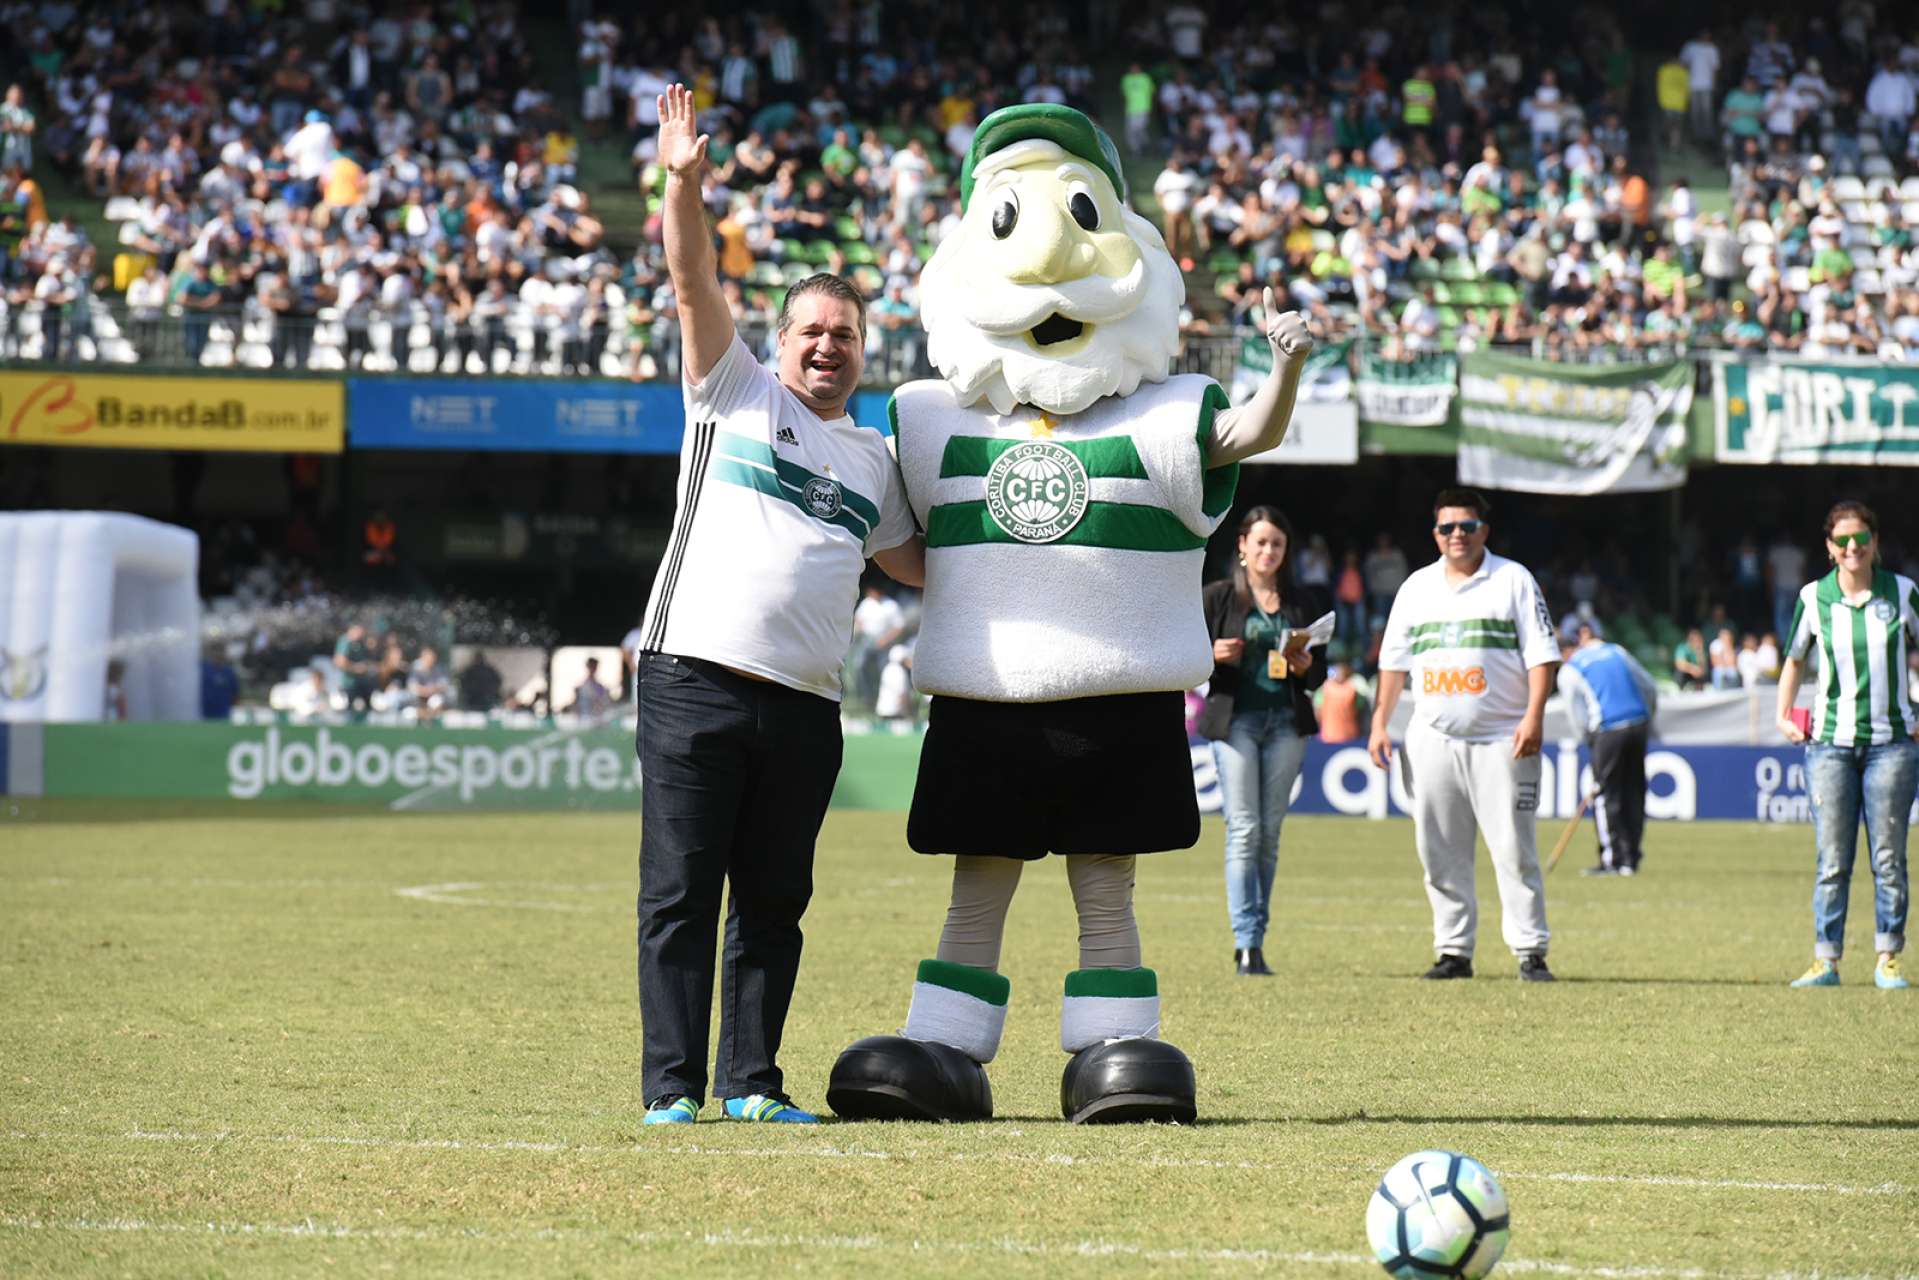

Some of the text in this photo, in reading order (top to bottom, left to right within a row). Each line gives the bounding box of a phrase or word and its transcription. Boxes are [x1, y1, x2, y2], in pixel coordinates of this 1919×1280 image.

[989, 445, 1086, 519] CORITIBA FOOT BALL CLUB
[1006, 478, 1066, 503] CFC
